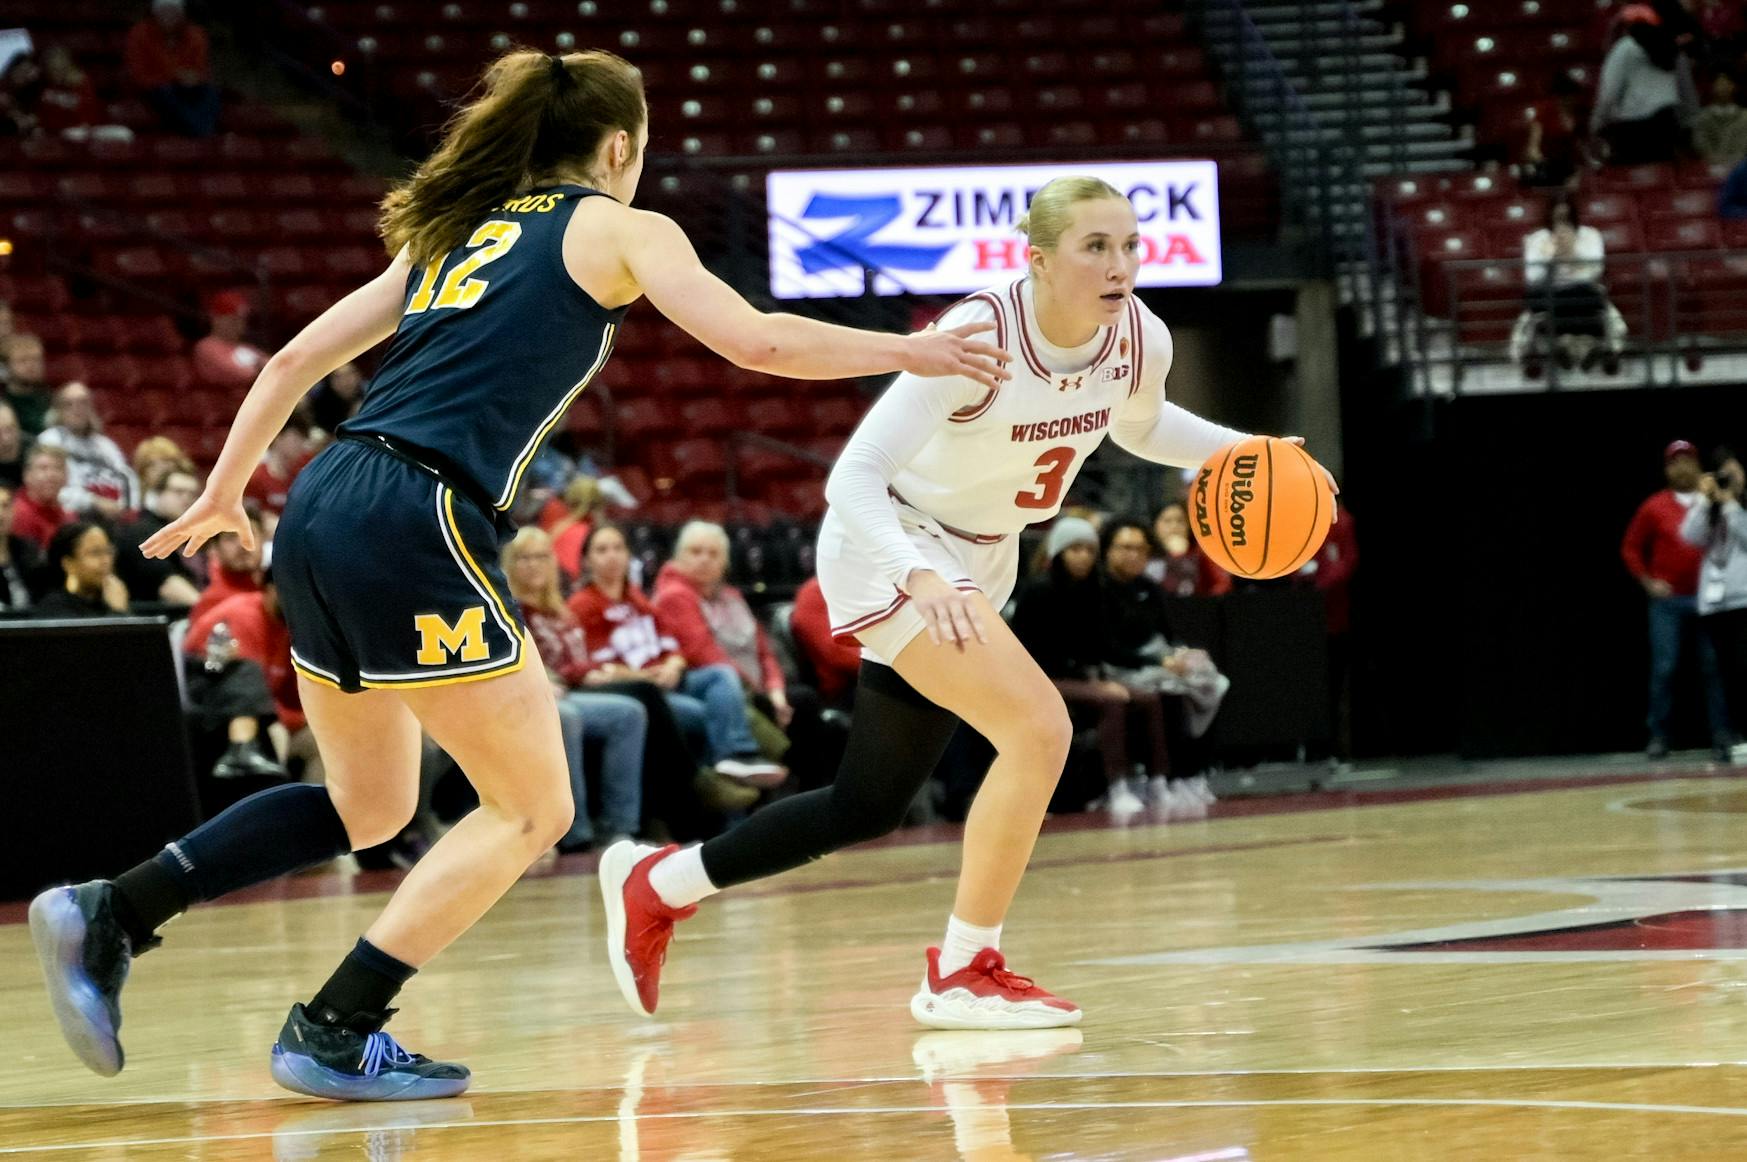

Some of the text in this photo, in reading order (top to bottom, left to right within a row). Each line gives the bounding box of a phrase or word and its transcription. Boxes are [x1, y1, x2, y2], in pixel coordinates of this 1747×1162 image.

[913, 183, 1204, 228] ZIMCK
[404, 220, 523, 315] 12
[973, 233, 1208, 271] HDA
[1010, 407, 1112, 442] WISCONSIN
[1014, 446, 1077, 509] 3
[1195, 468, 1213, 537] NCAA
[1230, 454, 1259, 547] Wilson
[414, 606, 491, 665] M
